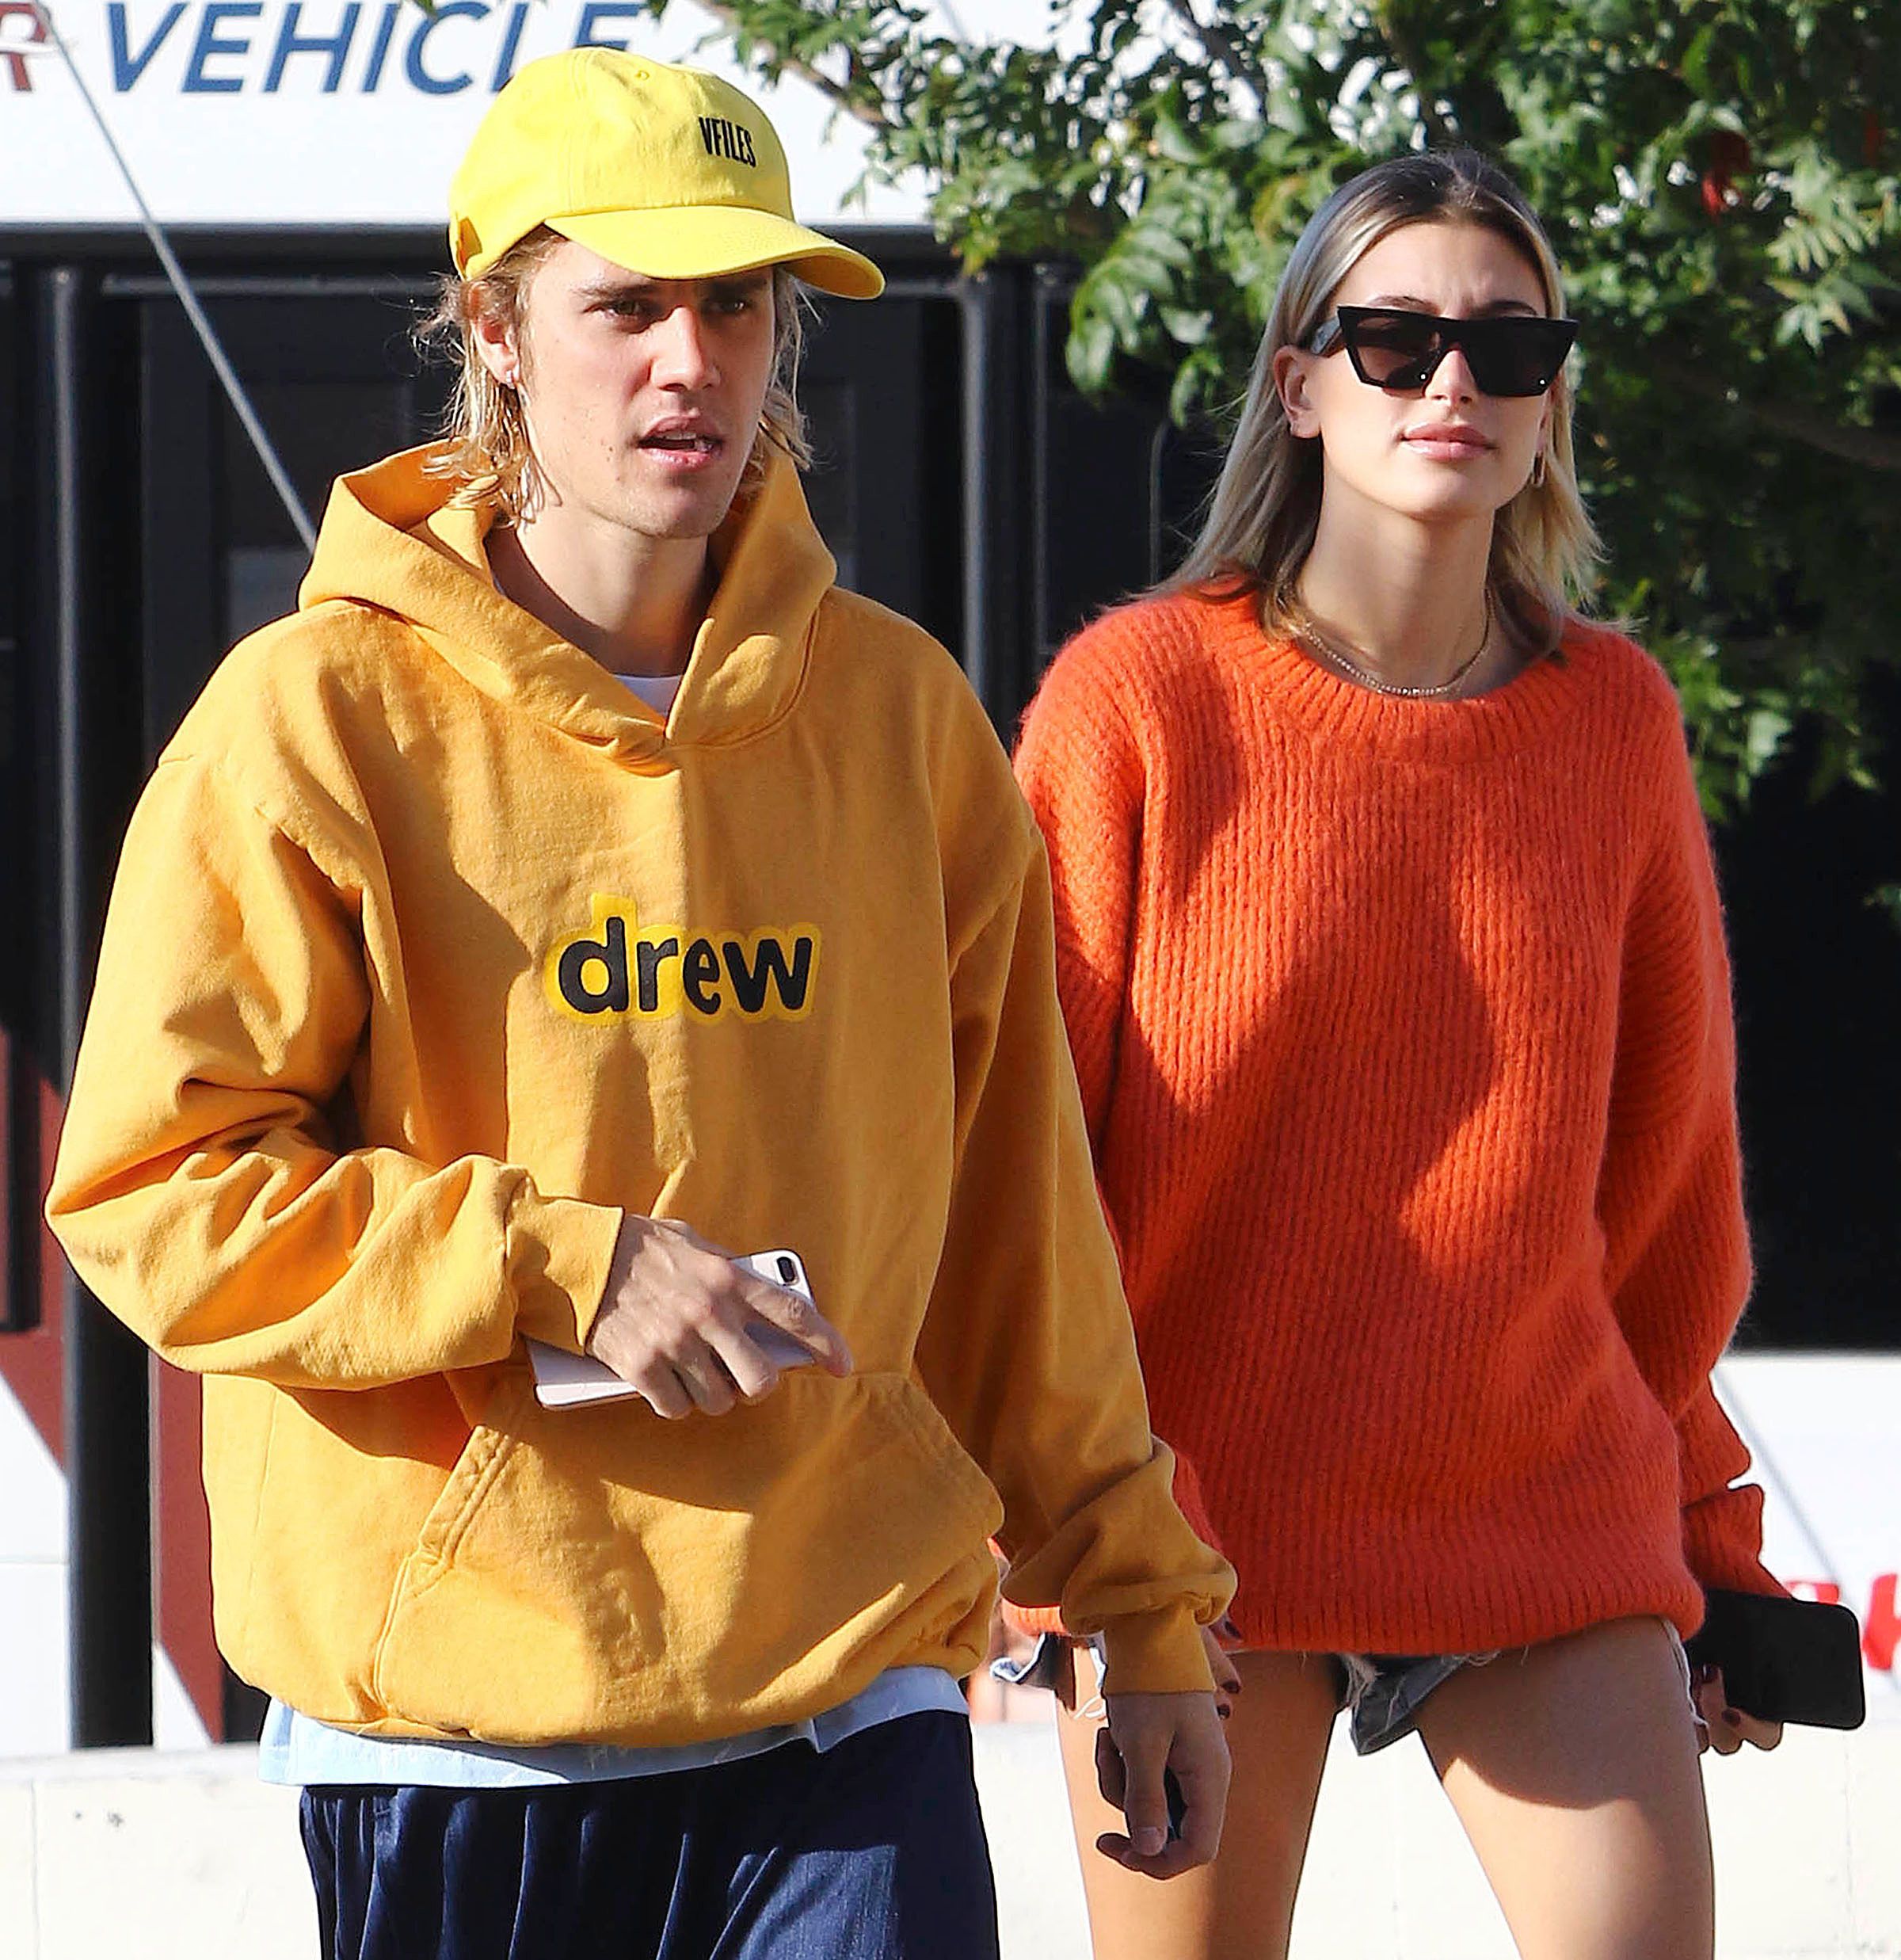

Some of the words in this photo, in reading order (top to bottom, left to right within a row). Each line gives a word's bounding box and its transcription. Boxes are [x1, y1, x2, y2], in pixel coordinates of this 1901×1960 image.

[109, 2, 642, 93] VEHICLE
[698, 116, 756, 168] VFILES
[558, 916, 813, 1015] drew
